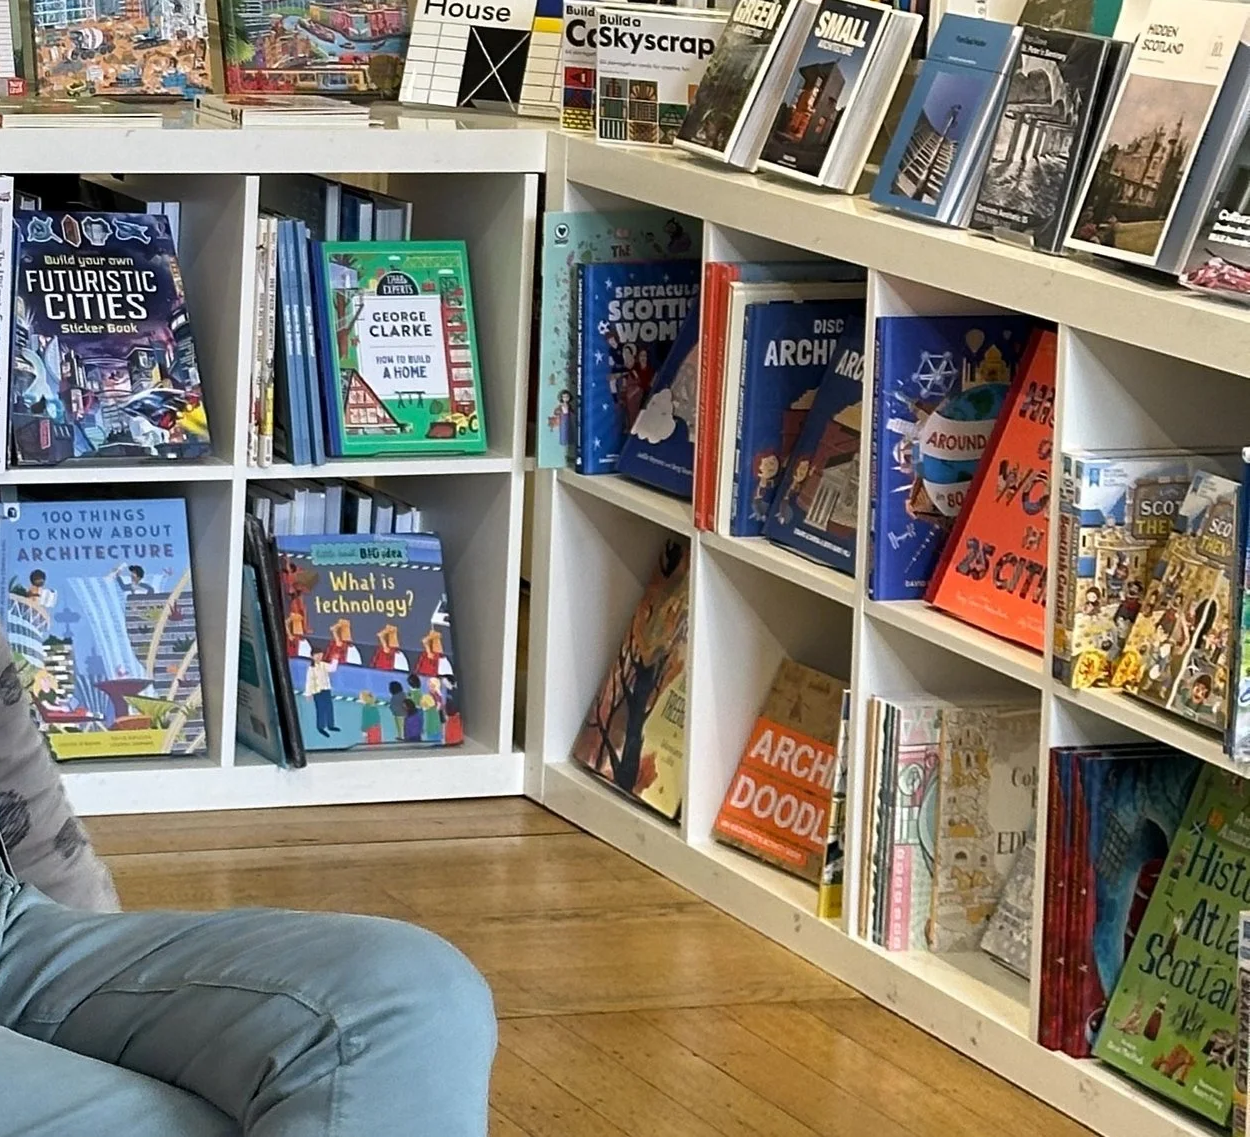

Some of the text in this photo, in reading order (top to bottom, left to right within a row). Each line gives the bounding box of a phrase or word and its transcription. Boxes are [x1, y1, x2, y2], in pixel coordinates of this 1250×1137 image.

[565, 5, 596, 18] Build
[599, 14, 642, 28] Build a
[814, 10, 871, 49] SMALL
[1147, 23, 1180, 38] HIDDEN
[599, 26, 716, 59] Skyscrap
[1141, 38, 1184, 55] SCOTLAND
[44, 254, 134, 269] Build your own
[25, 269, 157, 293] FUTURISTIC
[382, 284, 414, 295] EXPERTS
[45, 293, 148, 321] CITIES
[372, 311, 426, 323] GEORGE
[60, 322, 138, 334] Sticker Book
[369, 324, 433, 338] CLARKE
[615, 320, 685, 344] WOM
[813, 318, 844, 334] DISC
[376, 354, 432, 365] HOW TO BUILD
[383, 365, 428, 379] A HOME
[926, 430, 988, 451] AROUND
[41, 507, 146, 524] 100 THINGS
[17, 524, 172, 542] TO KNOW ABOUT
[17, 543, 175, 563] ARCHITECTURE
[359, 547, 380, 559] BIG
[329, 570, 395, 591] What is
[905, 579, 927, 588] DAVID
[315, 589, 415, 618] technology?
[730, 774, 826, 845] DOODL
